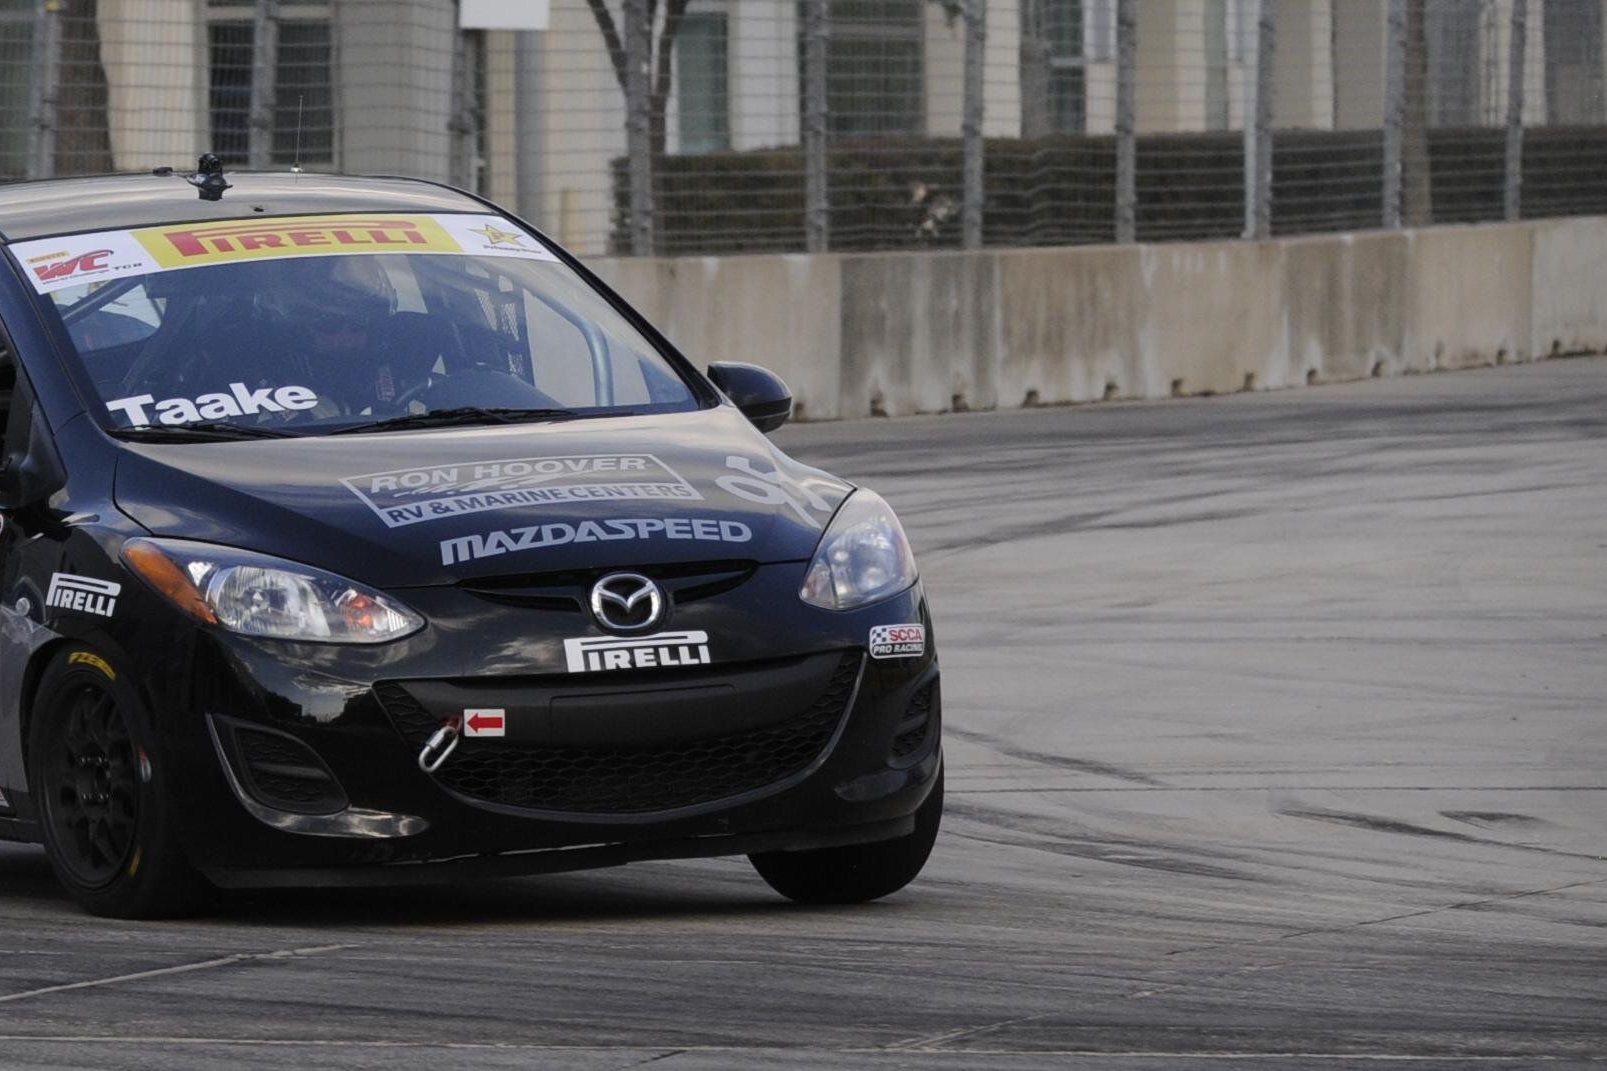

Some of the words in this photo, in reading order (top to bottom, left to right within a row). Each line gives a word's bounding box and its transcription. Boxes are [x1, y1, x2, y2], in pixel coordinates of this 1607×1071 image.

[163, 219, 427, 257] PIRELLI
[33, 250, 114, 280] WC
[106, 382, 318, 428] Taake
[371, 468, 457, 493] RON
[474, 457, 646, 479] HOOVER
[388, 507, 425, 525] RV
[430, 501, 457, 515] &
[458, 488, 567, 511] MARINE
[567, 484, 695, 500] CENTERS
[441, 518, 752, 566] MAZDASPEED
[46, 572, 121, 617] PIRELLI
[564, 630, 710, 672] PIRELLI
[874, 645, 892, 654] PRO
[894, 643, 923, 654] RACING
[889, 629, 922, 642] SCCA
